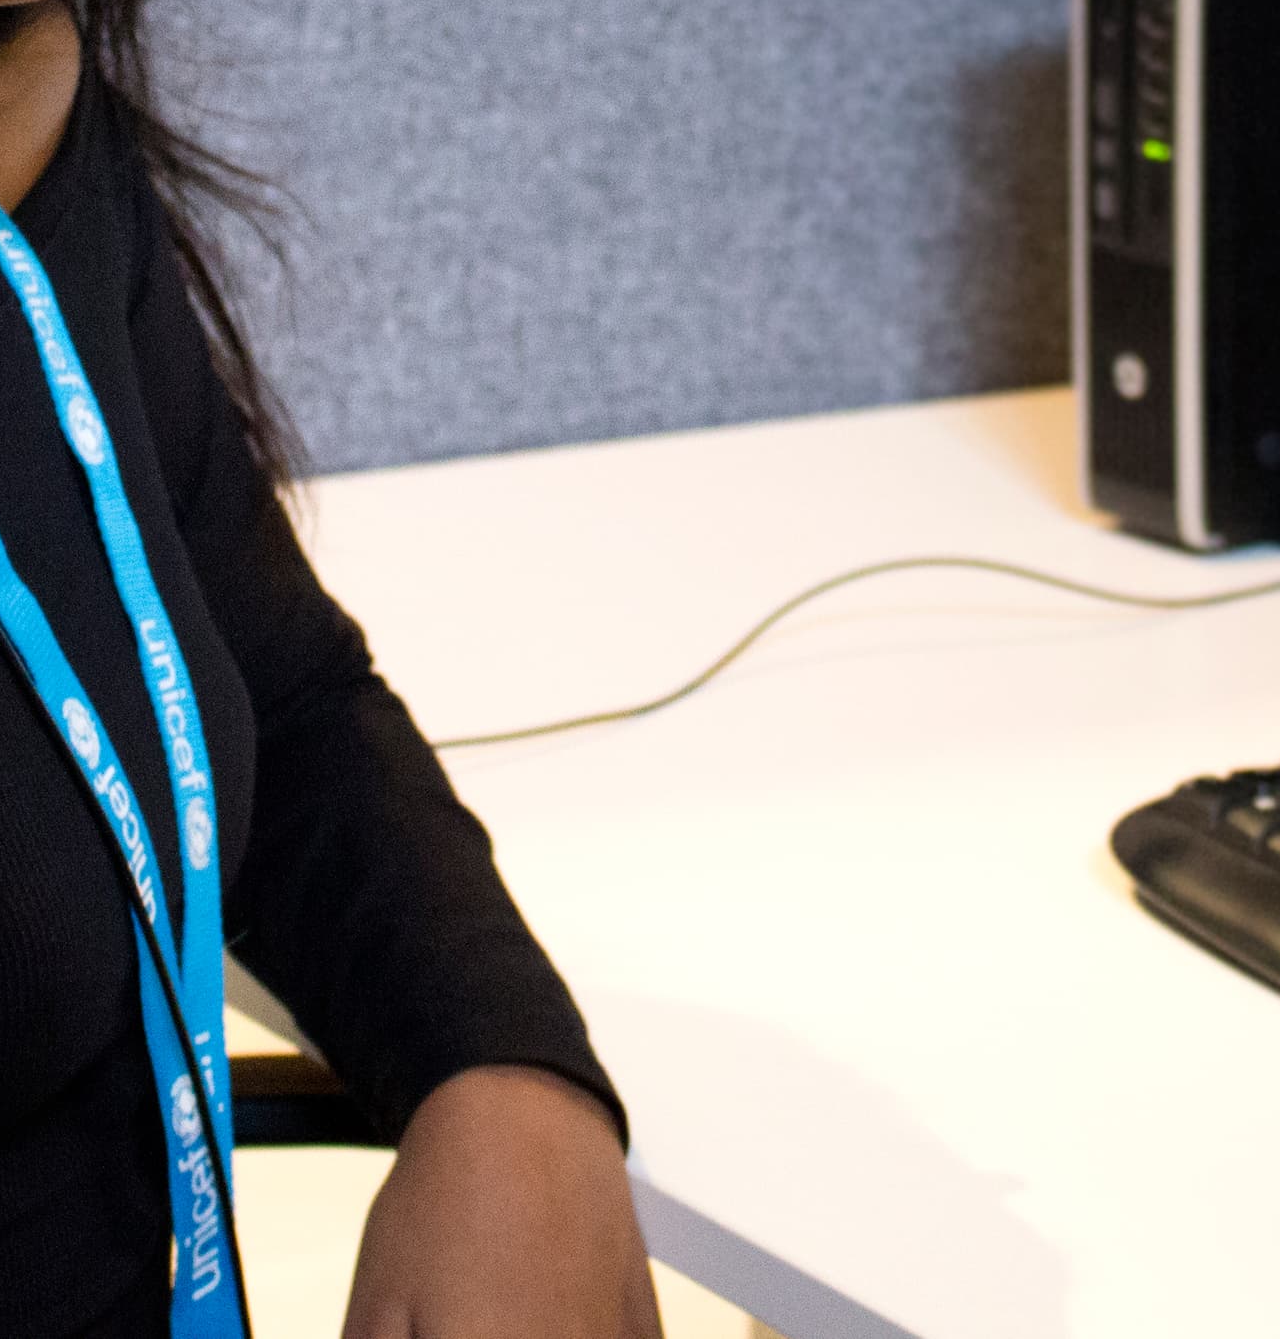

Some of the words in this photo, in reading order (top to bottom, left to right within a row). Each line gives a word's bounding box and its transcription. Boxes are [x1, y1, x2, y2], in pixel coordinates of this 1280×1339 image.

[140, 619, 207, 792] unicef
[93, 765, 157, 924] unicef
[178, 1144, 221, 1301] unicef
